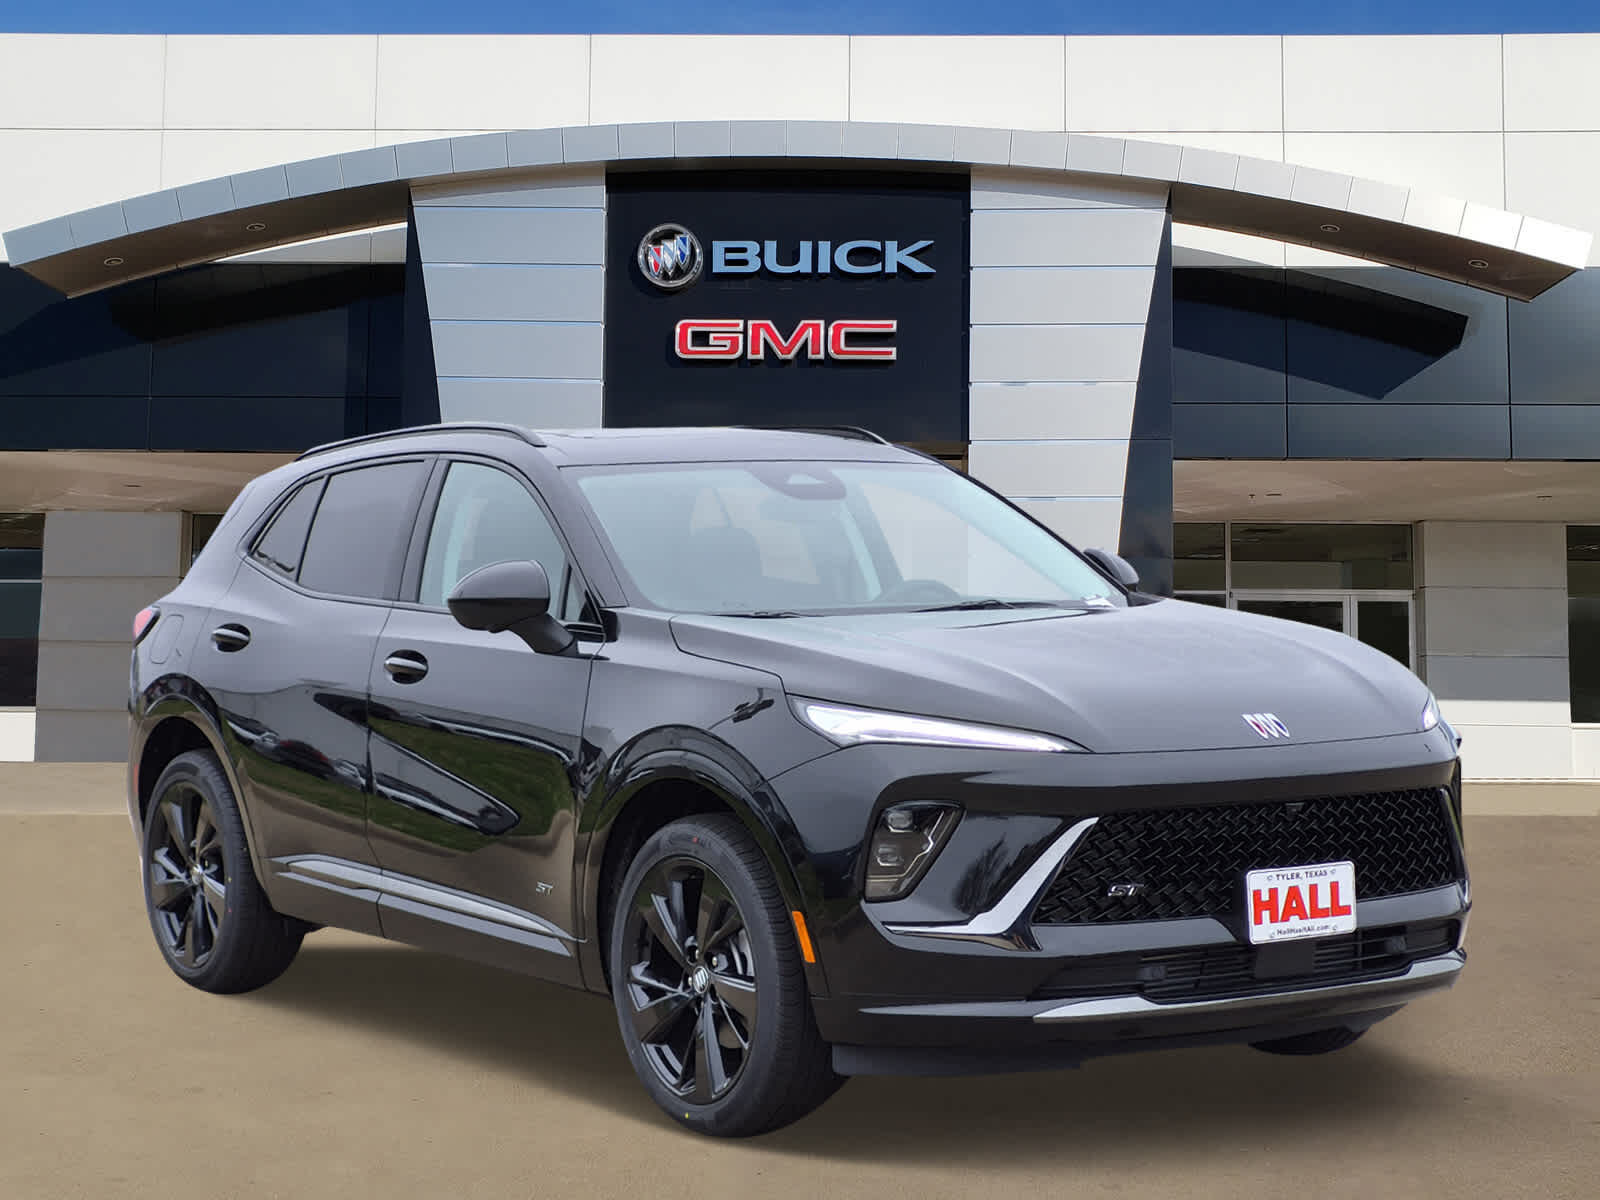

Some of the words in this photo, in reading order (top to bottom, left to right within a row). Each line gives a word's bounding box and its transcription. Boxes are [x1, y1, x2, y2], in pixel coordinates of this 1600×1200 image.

[711, 239, 937, 274] BUICK
[674, 319, 898, 361] GMC
[1276, 872, 1303, 881] TYLER,
[1304, 869, 1328, 879] TEXAS
[1252, 881, 1352, 926] HALL
